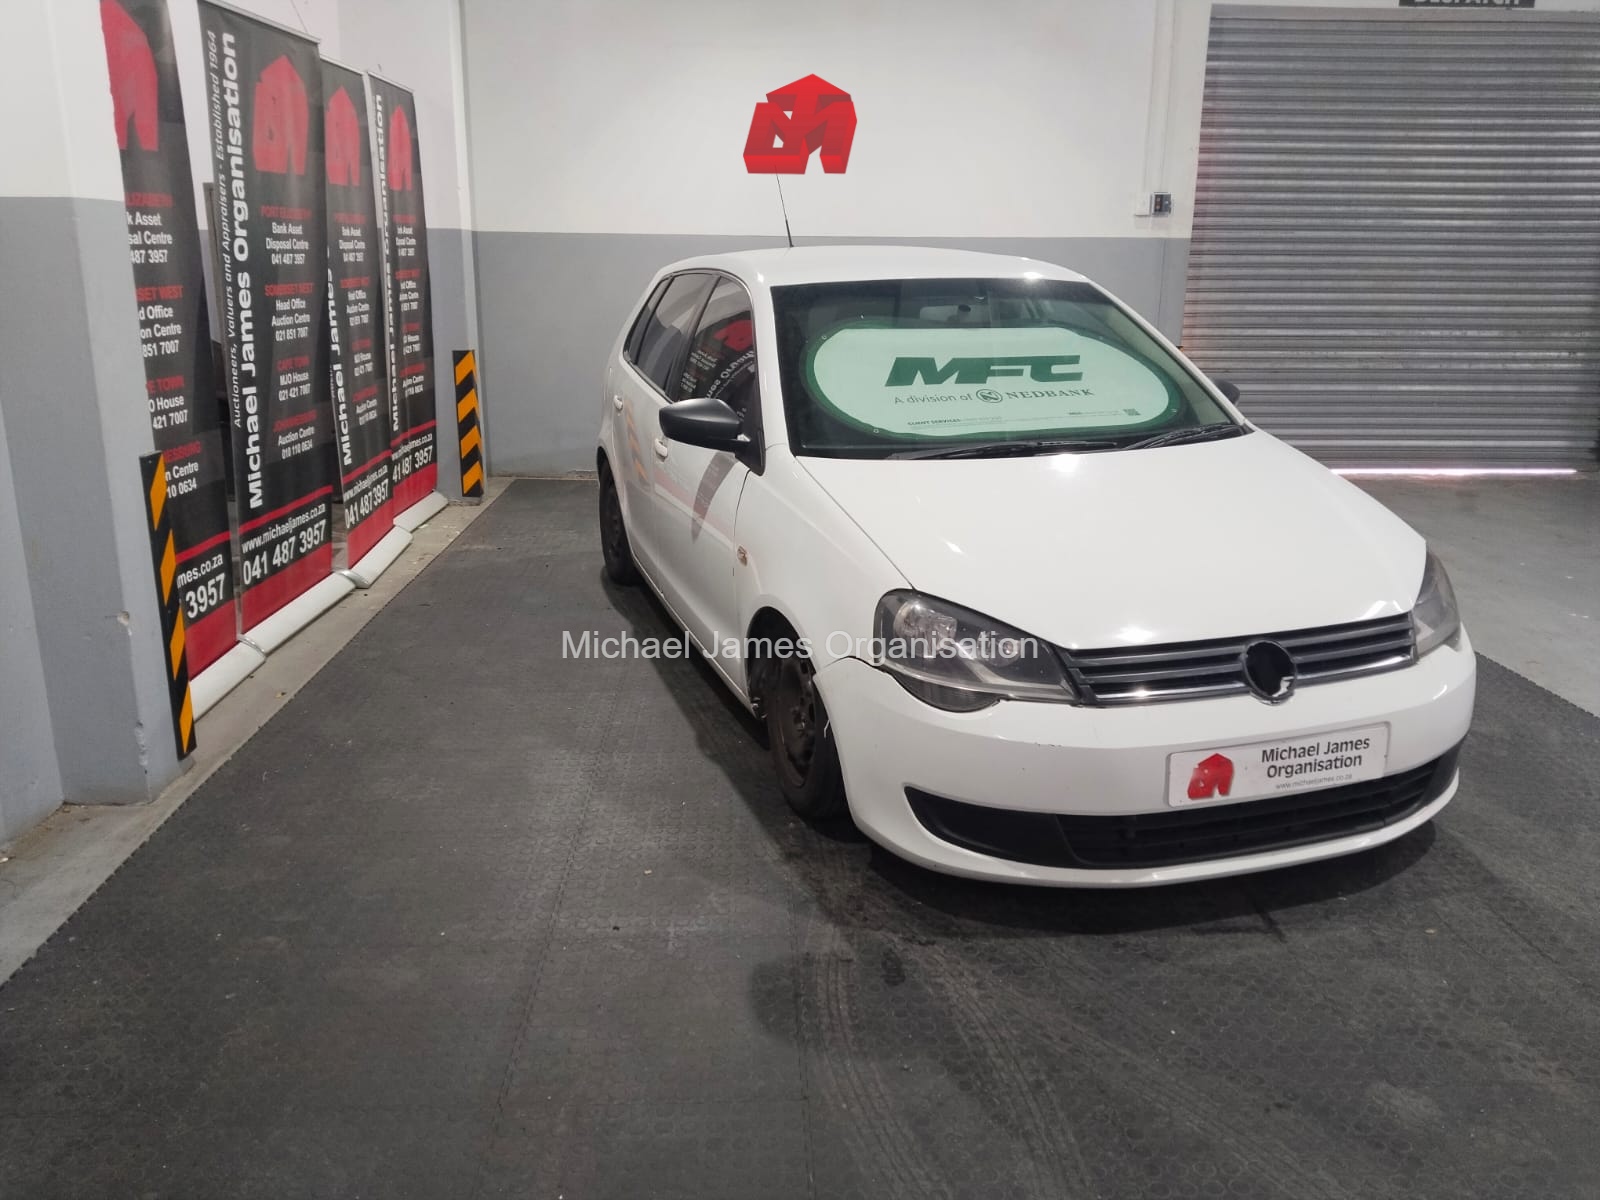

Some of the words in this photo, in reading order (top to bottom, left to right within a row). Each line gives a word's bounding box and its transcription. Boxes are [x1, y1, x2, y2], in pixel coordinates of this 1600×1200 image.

[207, 30, 218, 69] 1964
[210, 72, 225, 160] Established
[222, 33, 249, 262] Organisation
[135, 212, 162, 226] Asset
[218, 173, 231, 251] Appraisers
[144, 231, 173, 245] Centre
[266, 237, 292, 252] Disposal
[148, 250, 168, 263] 3957
[223, 253, 232, 281] and
[146, 305, 173, 319] Office
[224, 285, 236, 338] Valuers
[237, 271, 256, 377] James
[154, 324, 182, 337] Centre
[142, 344, 158, 357] 851
[160, 340, 179, 355] 7007
[885, 355, 1083, 387] MFC
[230, 344, 242, 428] Auctioneers,
[894, 396, 904, 404] A
[906, 394, 957, 404] division
[960, 393, 973, 401] of
[1006, 388, 1095, 400] NEDBANK
[156, 395, 184, 410] House
[333, 364, 352, 465] Michael
[152, 415, 167, 429] 421
[170, 410, 188, 425] 7007
[242, 386, 263, 509] Michael
[415, 445, 432, 468] 3957
[172, 462, 199, 479] Centre
[178, 478, 197, 494] 0634
[242, 503, 326, 554] www.michaeljames.co.za
[243, 551, 268, 585] 041
[272, 535, 296, 567] 487
[299, 518, 326, 553] 3957
[185, 573, 225, 618] 3957
[1261, 742, 1320, 763] Michael
[1324, 737, 1371, 756] James
[1266, 754, 1363, 779] Organisation
